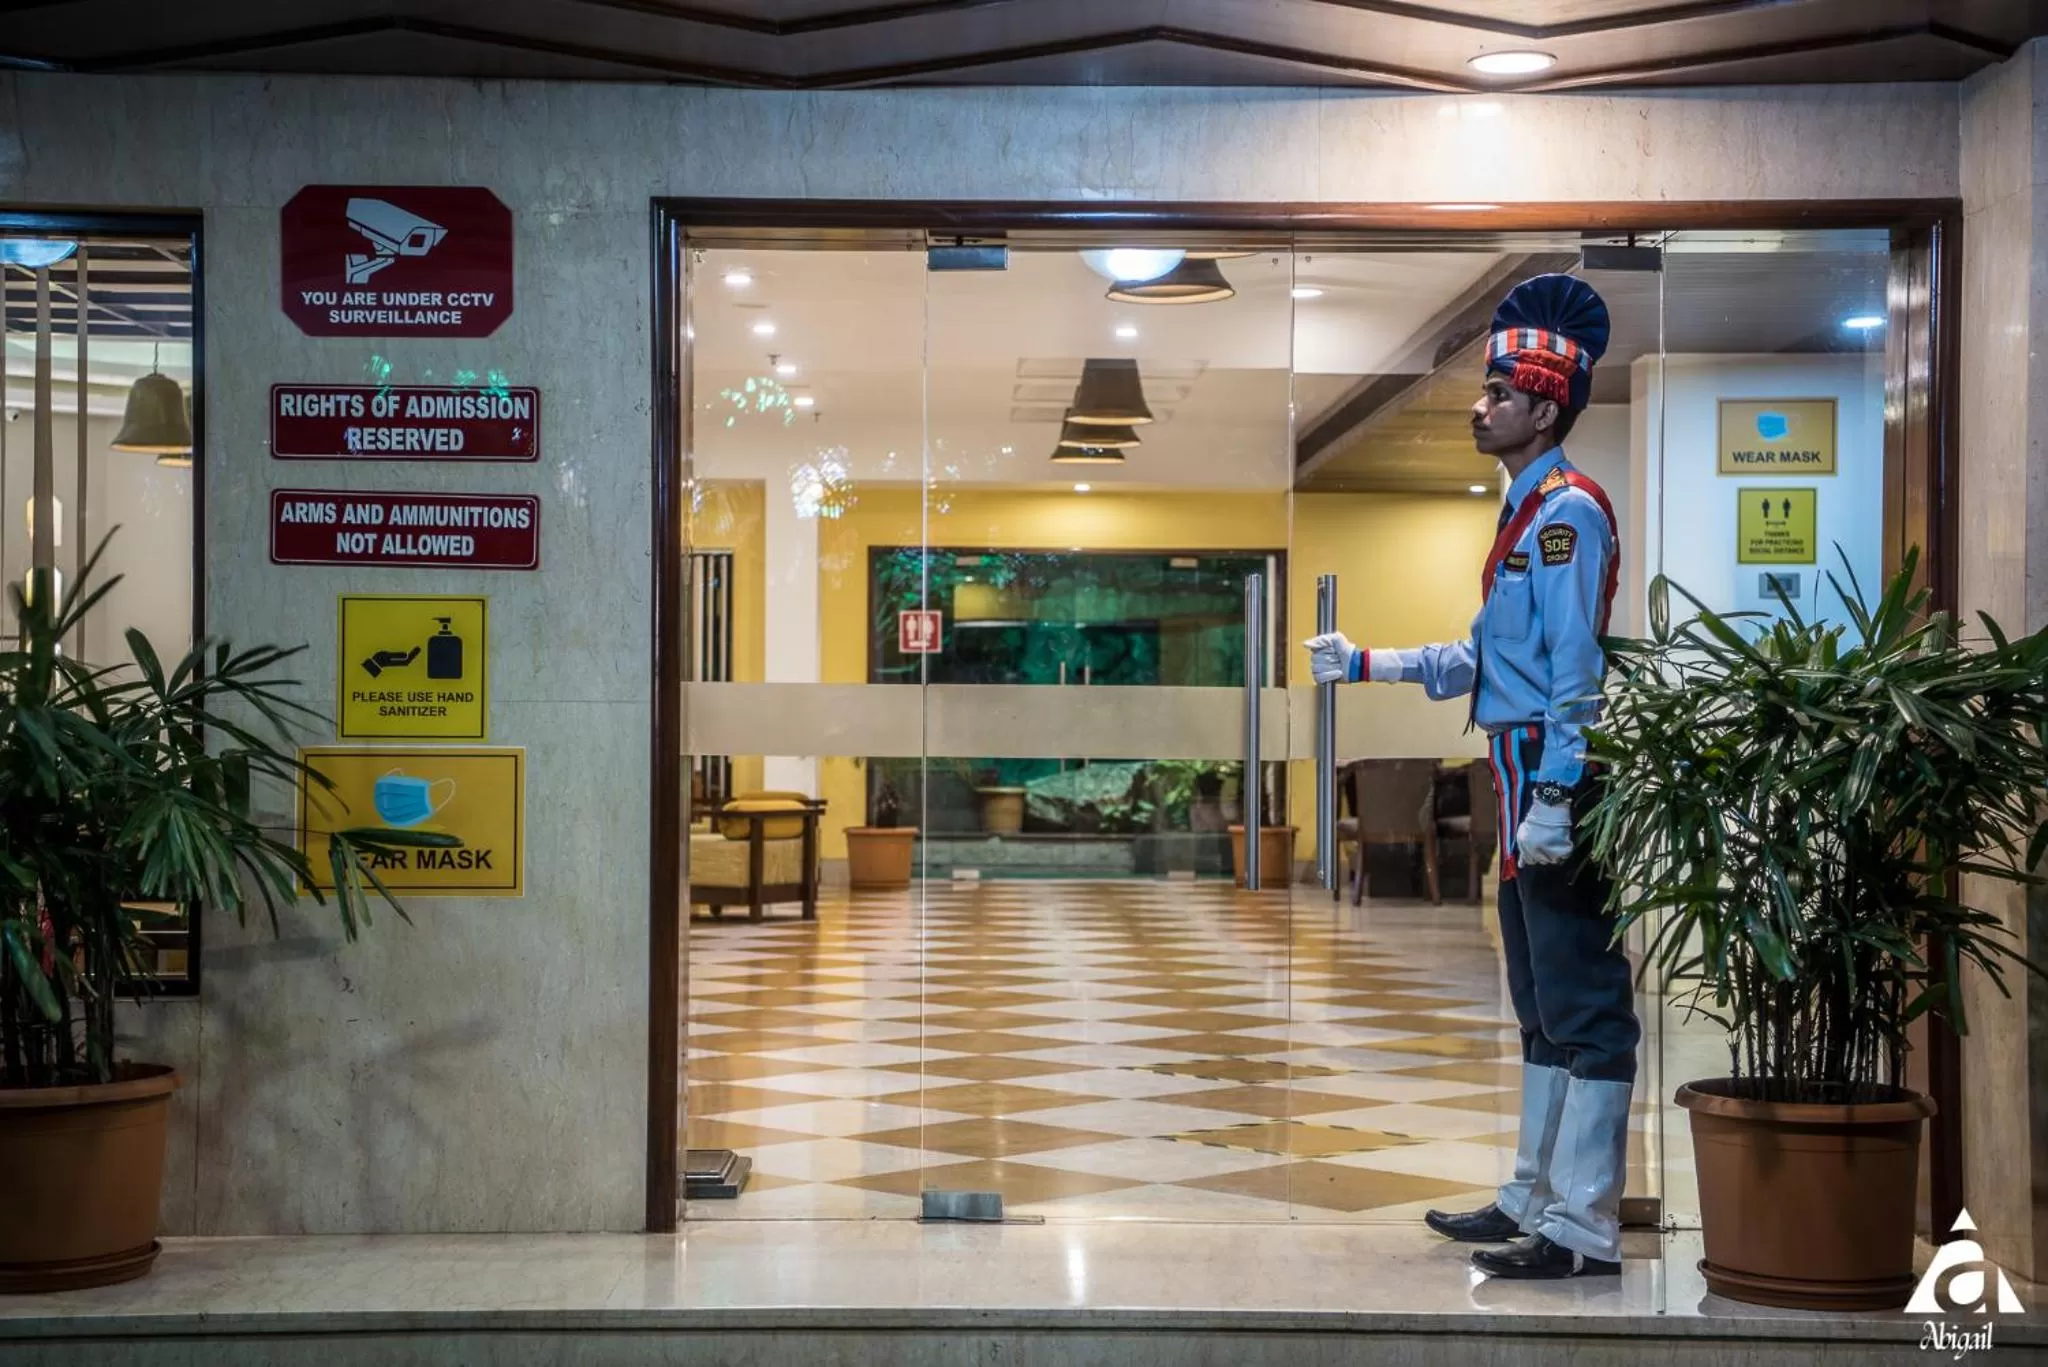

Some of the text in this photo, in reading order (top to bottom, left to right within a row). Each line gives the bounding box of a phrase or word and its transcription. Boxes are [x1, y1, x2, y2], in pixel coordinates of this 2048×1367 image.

[301, 292, 494, 306] YOU ARE UNDER CCTV
[329, 310, 462, 324] SURVEILLANCE
[280, 394, 529, 419] RIGHTS OF ADMISSION
[347, 428, 464, 450] RESERVED
[1732, 451, 1822, 463] WEAR MASK
[281, 502, 530, 528] ARMS AND AMMUNITIONS
[337, 533, 474, 556] NOT ALLOWED
[1544, 539, 1571, 552] SDE
[1546, 553, 1569, 562] GROUP
[352, 692, 474, 702] PLEASE USE HAND
[379, 706, 447, 717] SANITIZER
[416, 850, 492, 869] MASK
